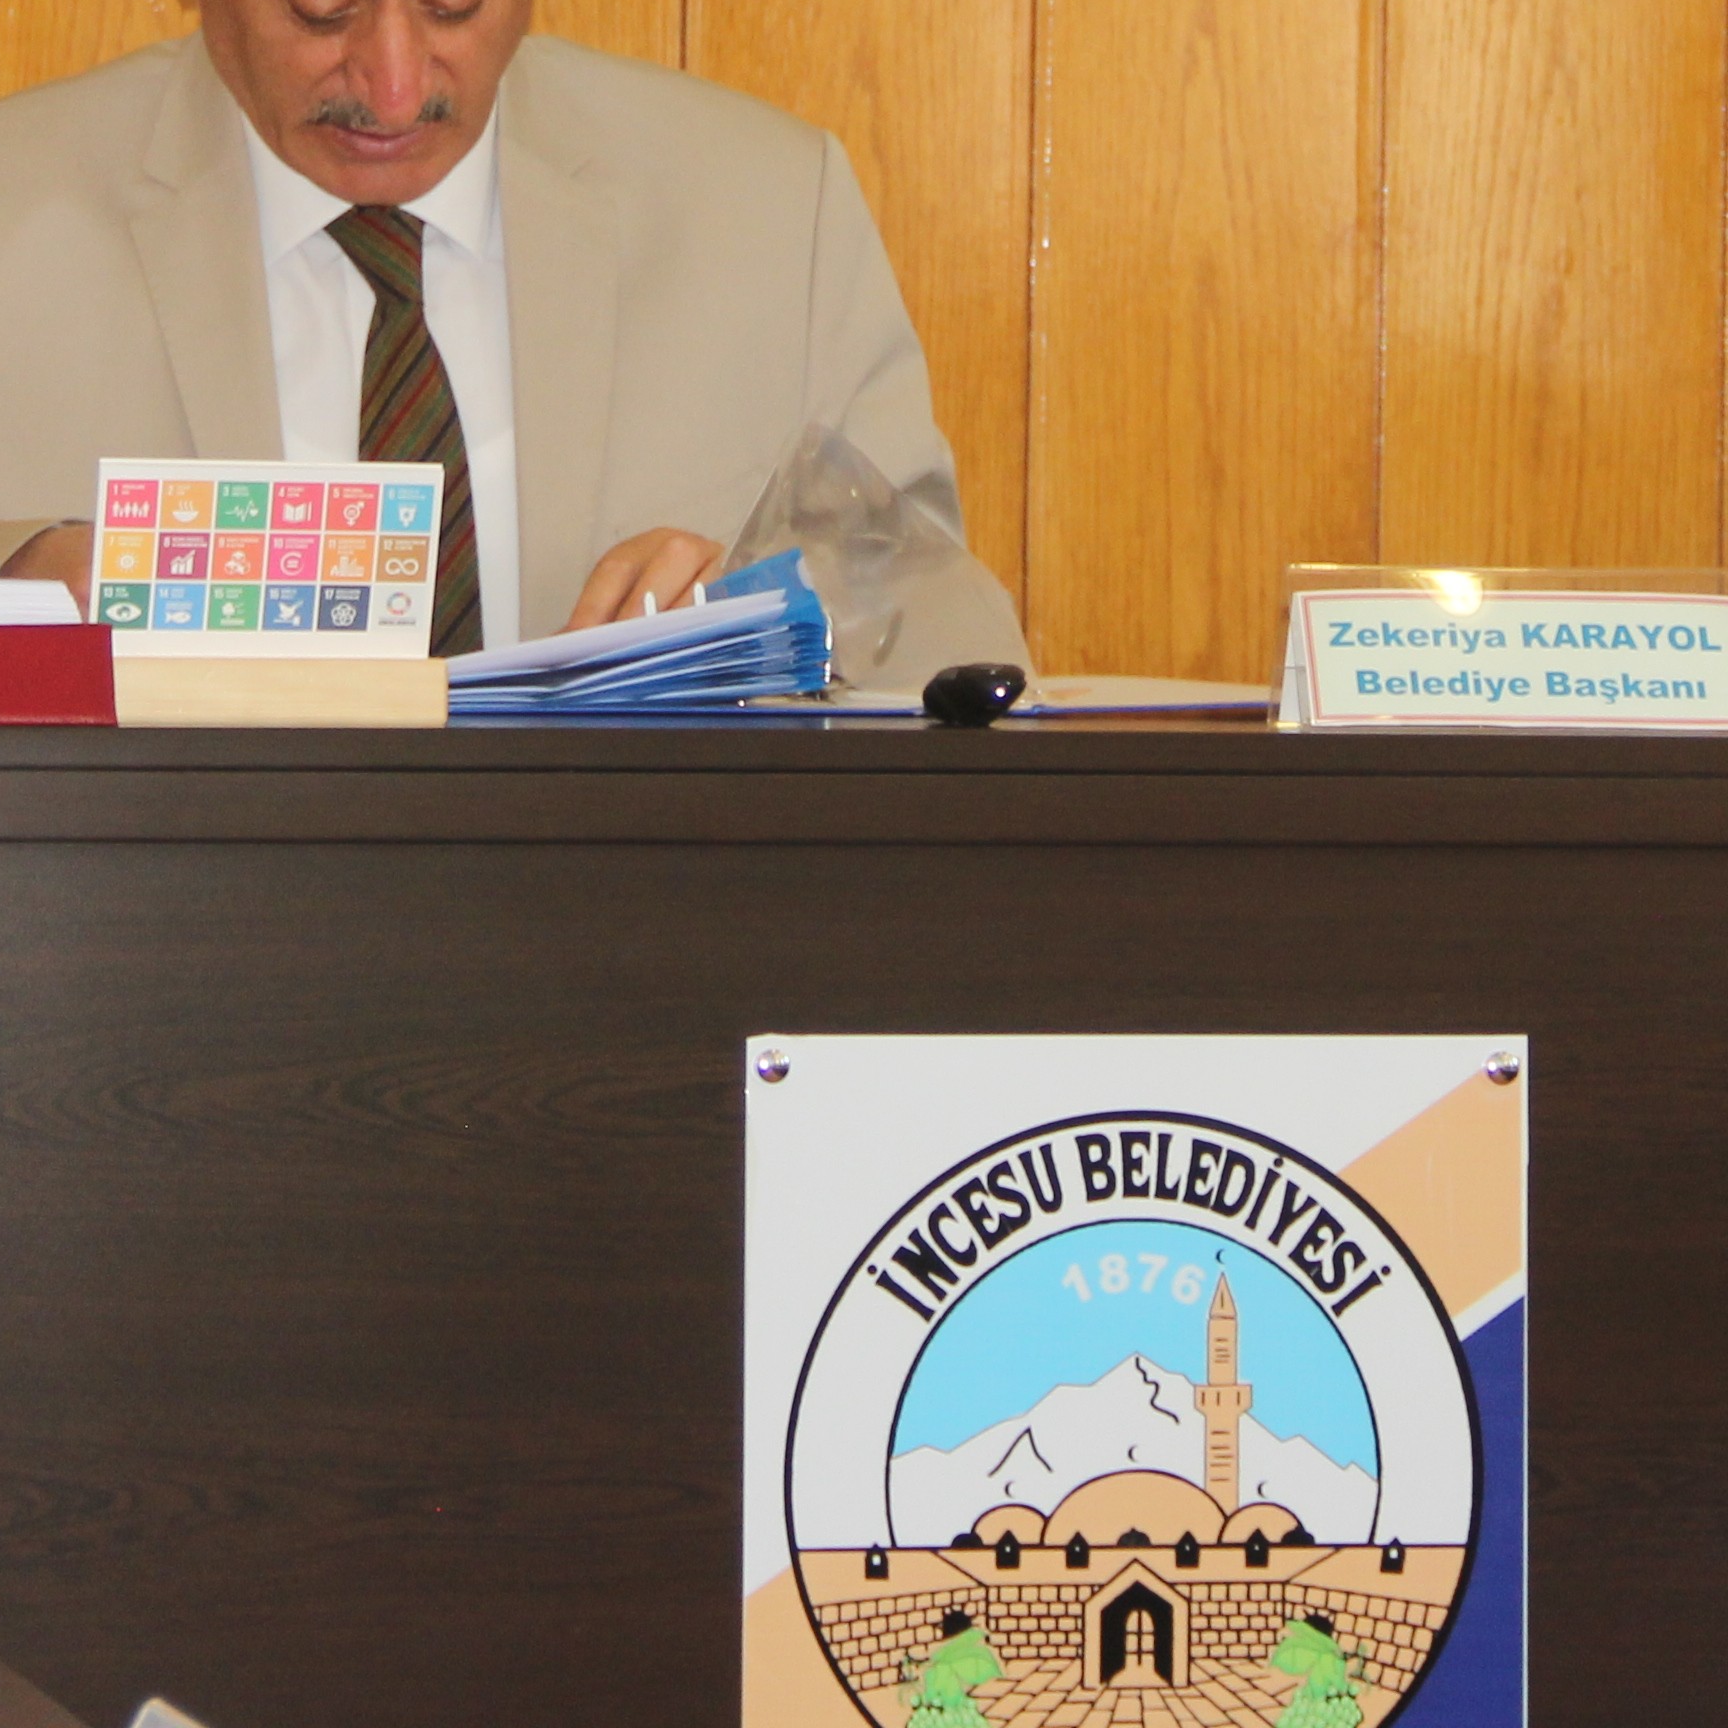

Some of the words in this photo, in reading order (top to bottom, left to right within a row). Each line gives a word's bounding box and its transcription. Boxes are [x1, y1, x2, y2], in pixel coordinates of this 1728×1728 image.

[1329, 622, 1506, 654] Zekeriya
[1521, 622, 1722, 652] KARAYOL
[1356, 670, 1531, 702] Belediye
[1546, 671, 1706, 703] Başkanı
[867, 1143, 1064, 1322] İNCESU
[1075, 1131, 1392, 1318] BELEDİYESİ
[1061, 1252, 1208, 1306] 1876
